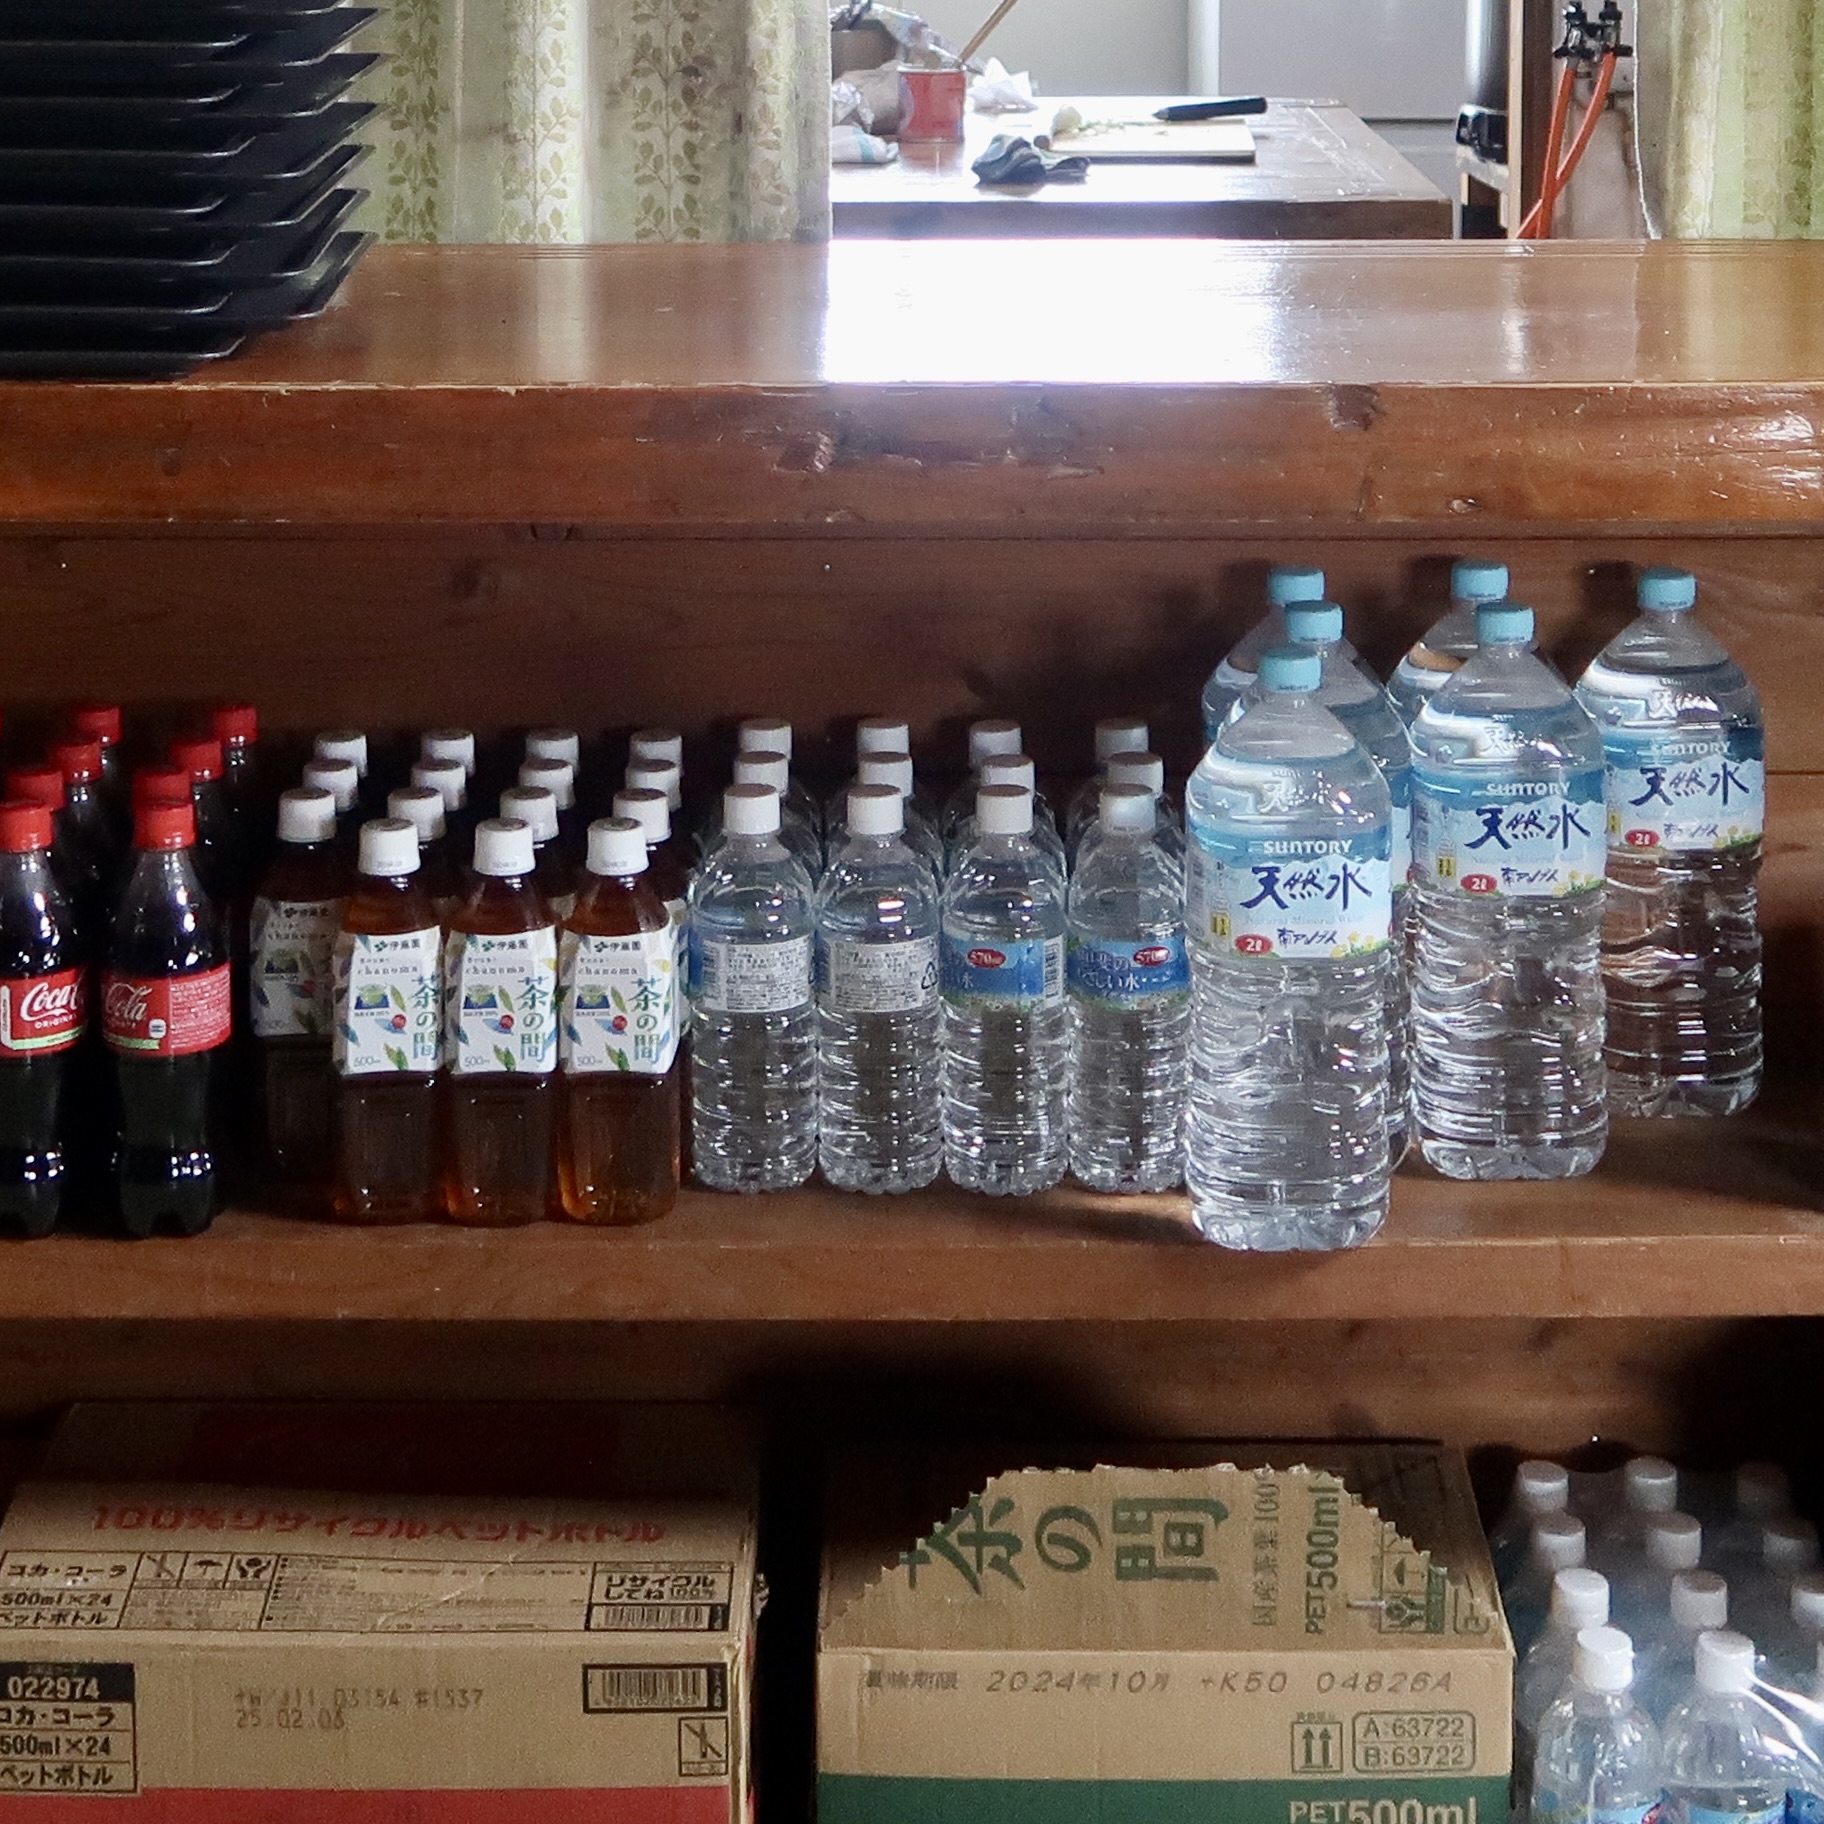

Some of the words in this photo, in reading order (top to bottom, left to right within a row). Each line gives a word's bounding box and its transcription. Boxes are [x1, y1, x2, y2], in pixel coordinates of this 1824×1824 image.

[1486, 782, 1571, 796] SUNTORY
[1628, 762, 1750, 807] 天然水
[1464, 803, 1592, 850] 天然水
[1263, 840, 1353, 855] SUNTORY
[1239, 863, 1373, 911] 天然水
[388, 938, 420, 951] 伊藤園
[497, 939, 529, 951] 伊藤園
[609, 940, 642, 952] 伊藤園
[1277, 928, 1338, 949] 南アルプス
[409, 974, 440, 1061] 茶の間
[517, 976, 552, 1063] 茶の間
[630, 977, 664, 1063] 茶の間
[92, 1505, 666, 1544] 100%リサイクルペットボトル
[7, 1563, 127, 1578] コカ・コーラ
[606, 1574, 716, 1590] リサイクル
[0, 1592, 112, 1607] 500ml×24
[7, 1676, 101, 1700] 022974
[1362, 1718, 1465, 1740] A:63722
[1364, 1747, 1465, 1768] B:63722
[0, 1765, 113, 1785] ペットボトル
